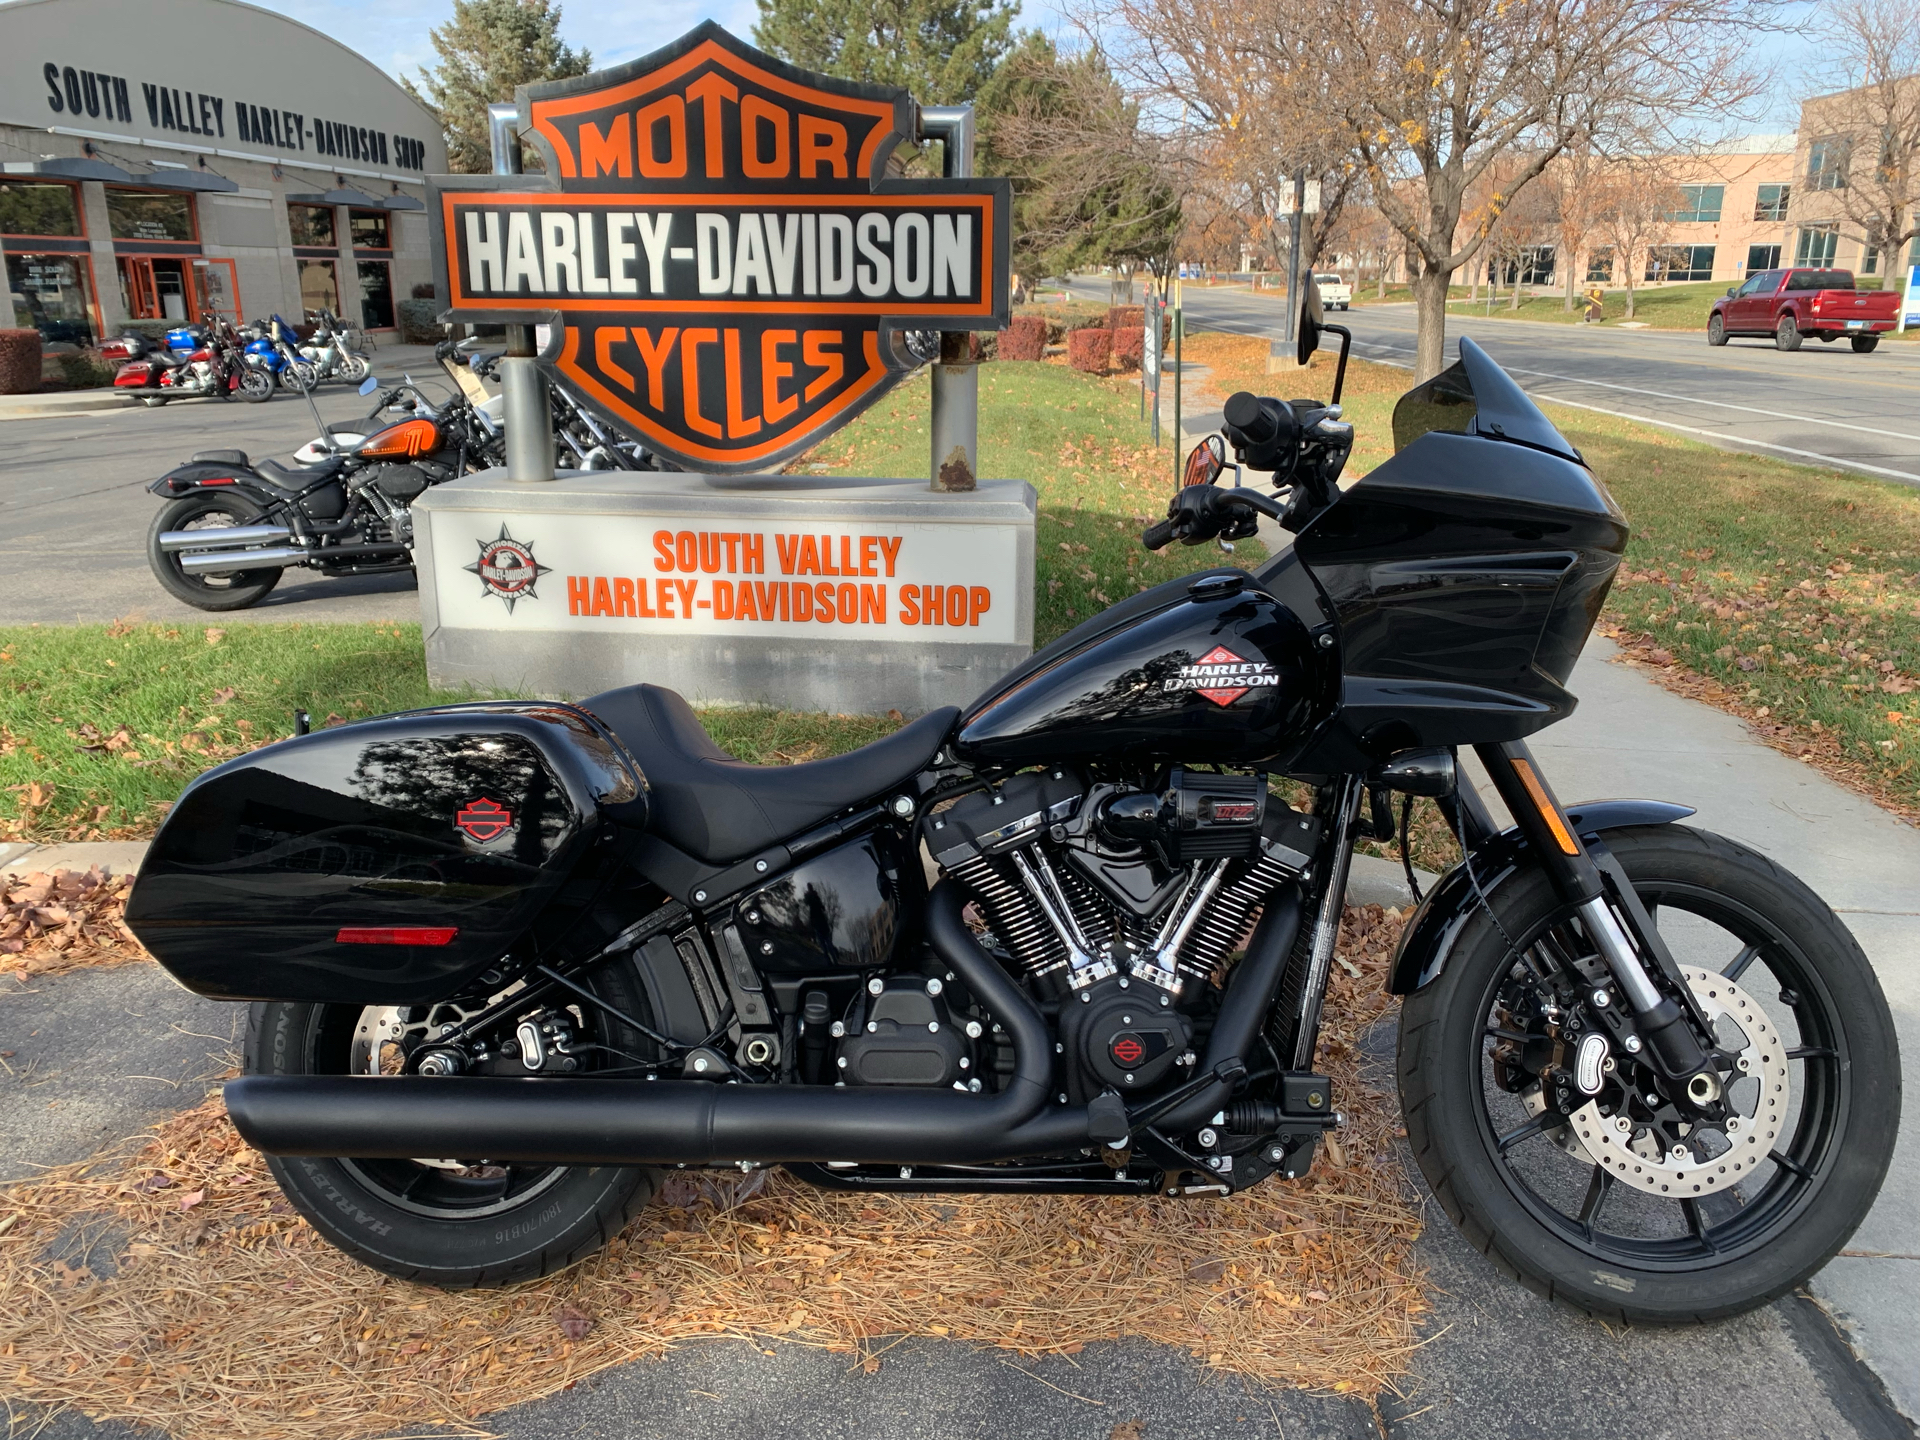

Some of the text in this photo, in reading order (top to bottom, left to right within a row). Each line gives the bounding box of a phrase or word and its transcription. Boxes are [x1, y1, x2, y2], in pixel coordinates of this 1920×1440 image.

[43, 62, 425, 171] SOUTH VALLEY HARLEY-DAVIDSON SHOP
[579, 71, 848, 179] MOTOR
[464, 211, 972, 297] HARLEY-DAVIDSON
[595, 328, 844, 440] CYCLES
[482, 540, 531, 559] AUTHORIZED
[482, 564, 533, 582] HARLEY-DAVIDSON
[652, 530, 903, 578] SOUTH VALLEY
[486, 582, 531, 599] RENTALS
[567, 575, 991, 627] HARLEY-DAVIDSON SHOP
[1164, 674, 1280, 692] DAVIDSON
